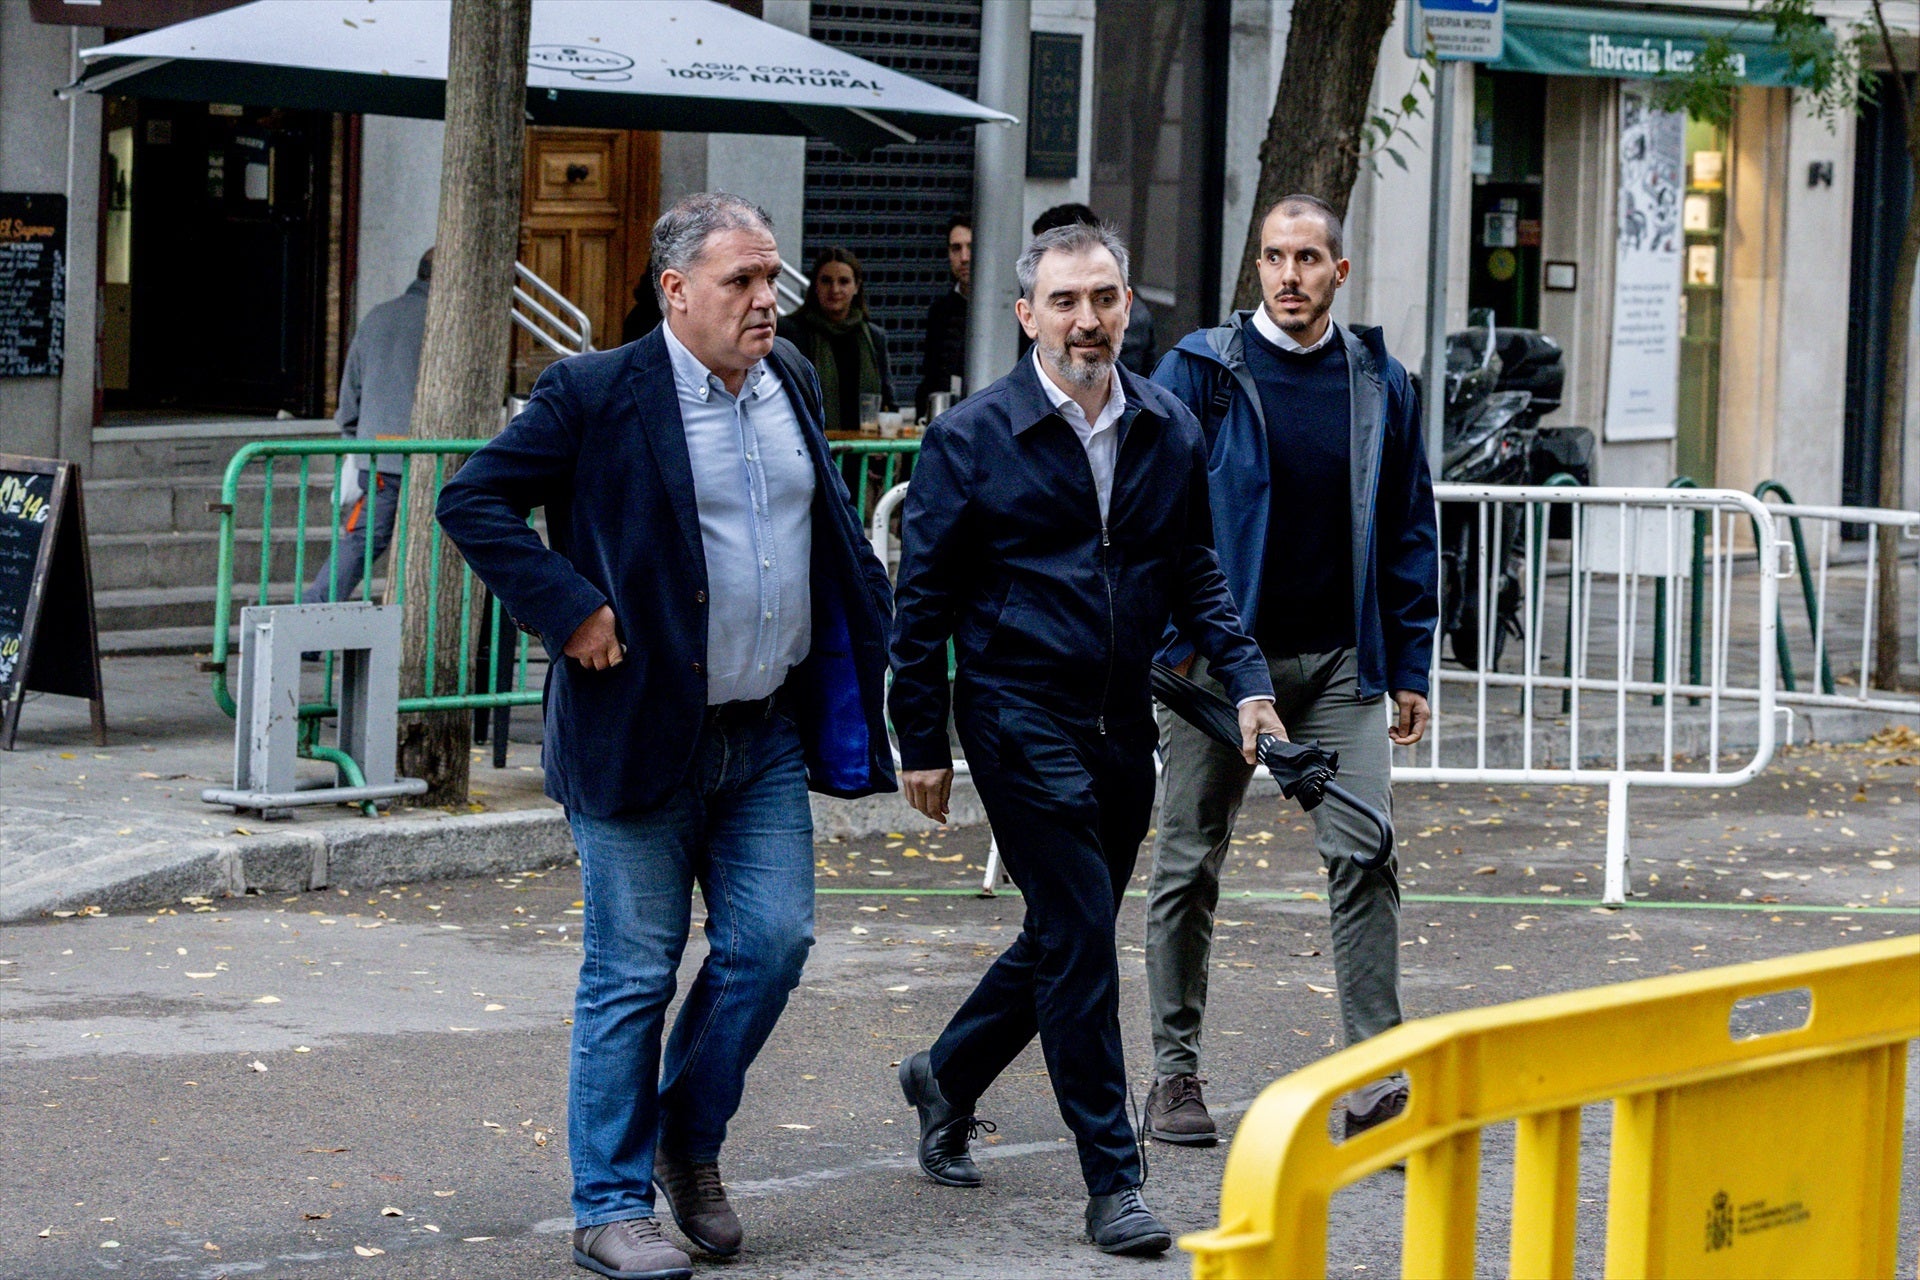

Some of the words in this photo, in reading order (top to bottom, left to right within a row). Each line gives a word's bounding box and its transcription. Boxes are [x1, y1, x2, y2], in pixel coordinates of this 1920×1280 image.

[1463, 18, 1491, 30] MOTOS
[1589, 33, 1661, 73] librería
[666, 67, 741, 82] 100%
[749, 73, 885, 91] NATURAL
[690, 61, 749, 72] AGUA
[756, 65, 802, 75] CON
[809, 68, 851, 78] GAS
[18, 493, 50, 523] 14€
